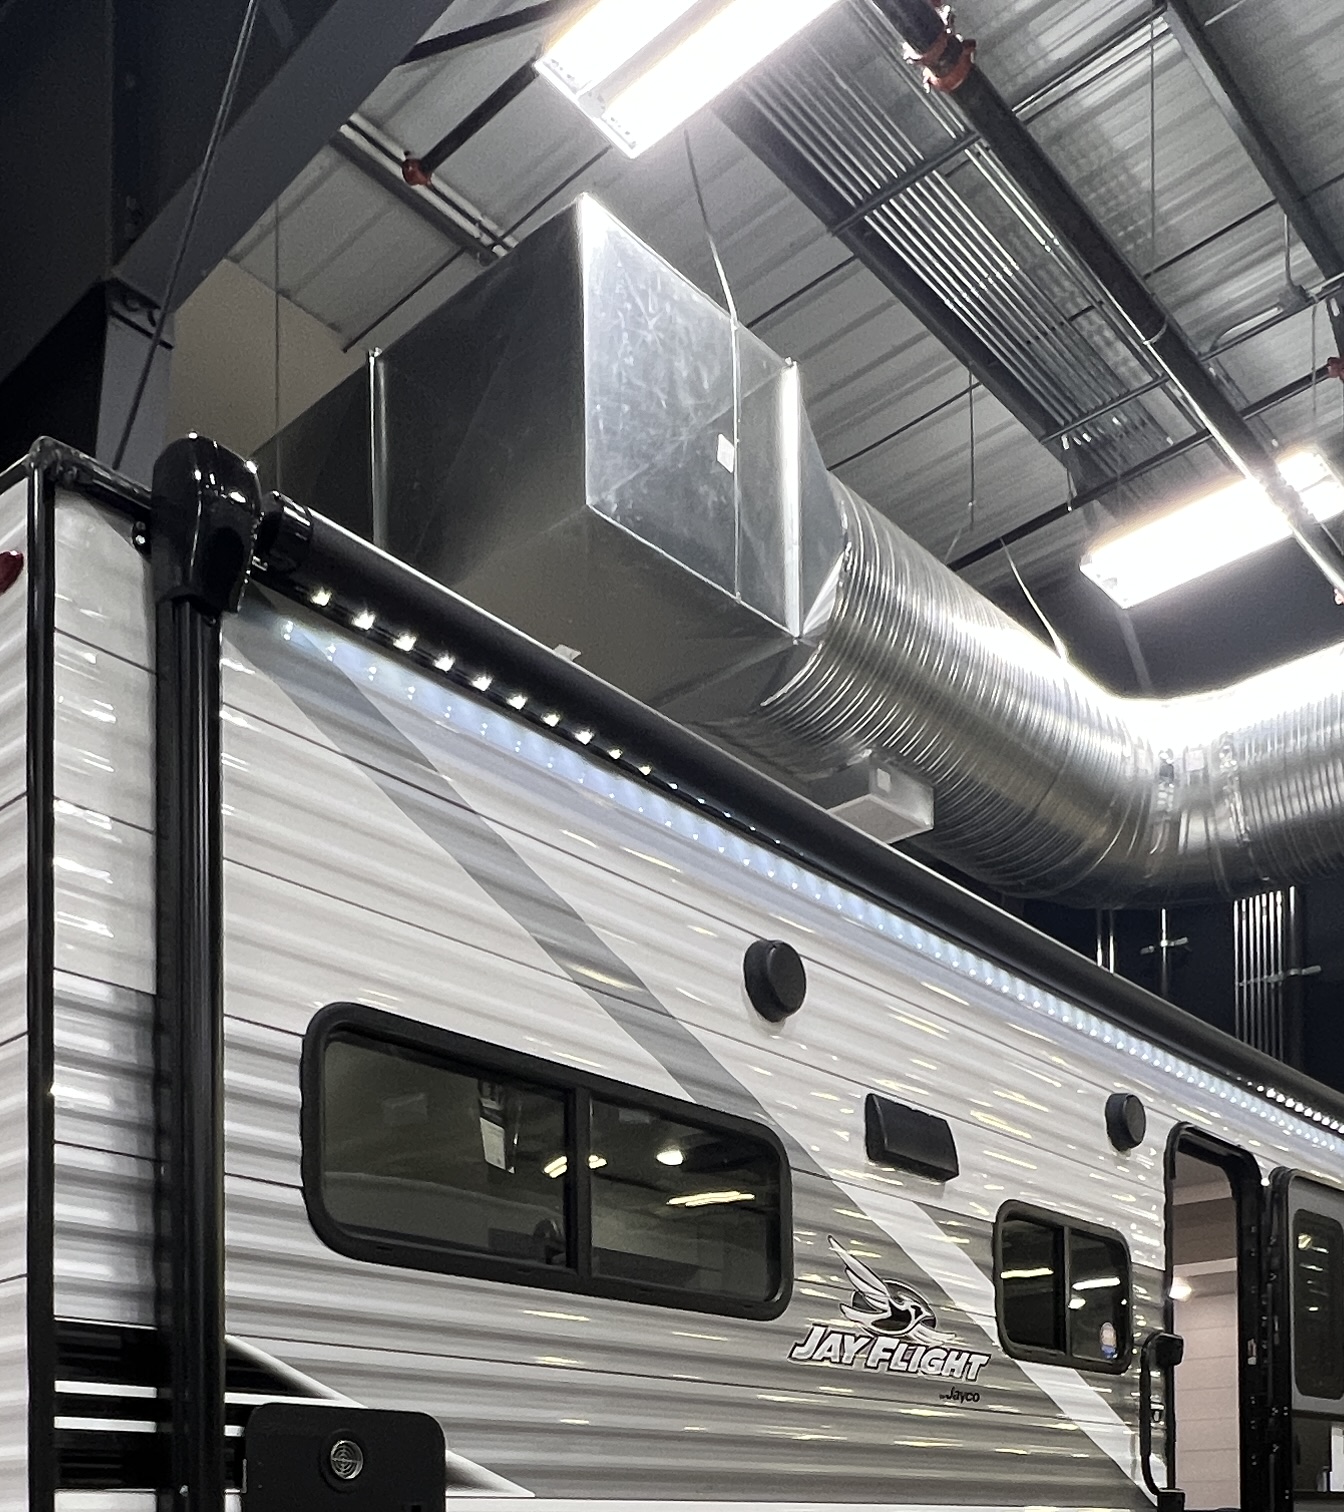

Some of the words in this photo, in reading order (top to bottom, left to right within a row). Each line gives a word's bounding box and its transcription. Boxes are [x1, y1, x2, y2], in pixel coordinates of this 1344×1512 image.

[790, 1325, 870, 1364] JAY
[865, 1337, 991, 1381] FLIGHT
[946, 1386, 980, 1404] Jayco
